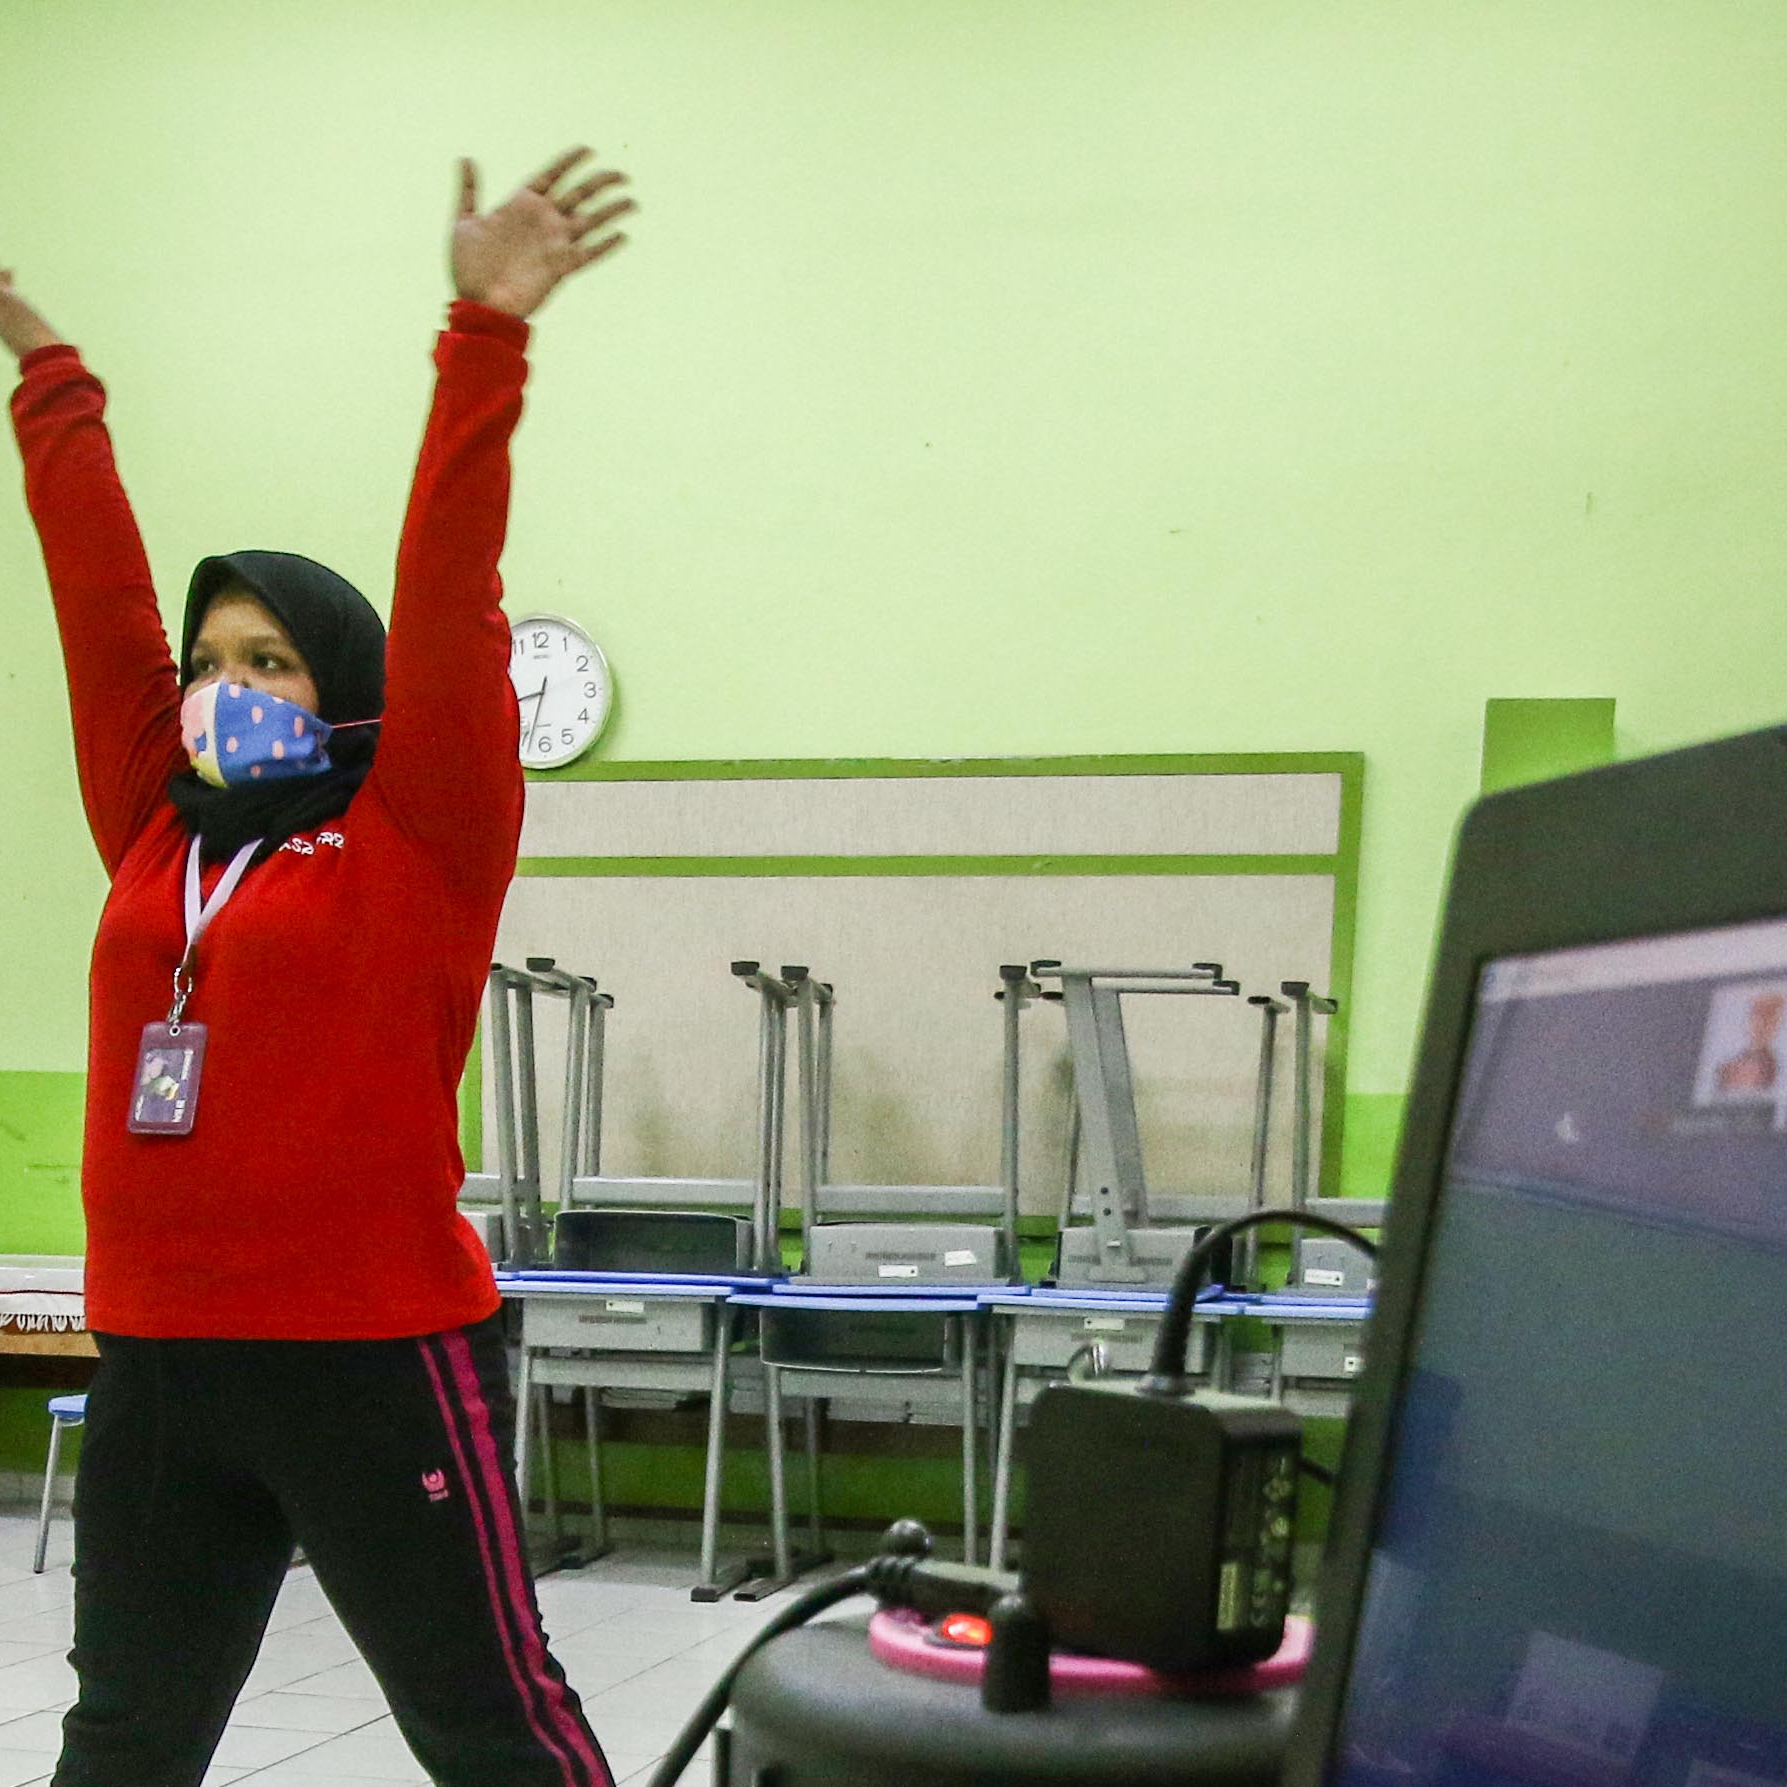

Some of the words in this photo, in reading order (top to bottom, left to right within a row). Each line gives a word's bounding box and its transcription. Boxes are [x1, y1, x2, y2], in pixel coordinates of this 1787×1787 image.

[532, 631, 550, 649] 12
[562, 637, 569, 652] 1
[576, 655, 589, 672] 2
[584, 682, 597, 698] 3
[578, 708, 590, 724] 4
[538, 736, 552, 753] 6
[561, 728, 574, 745] 5
